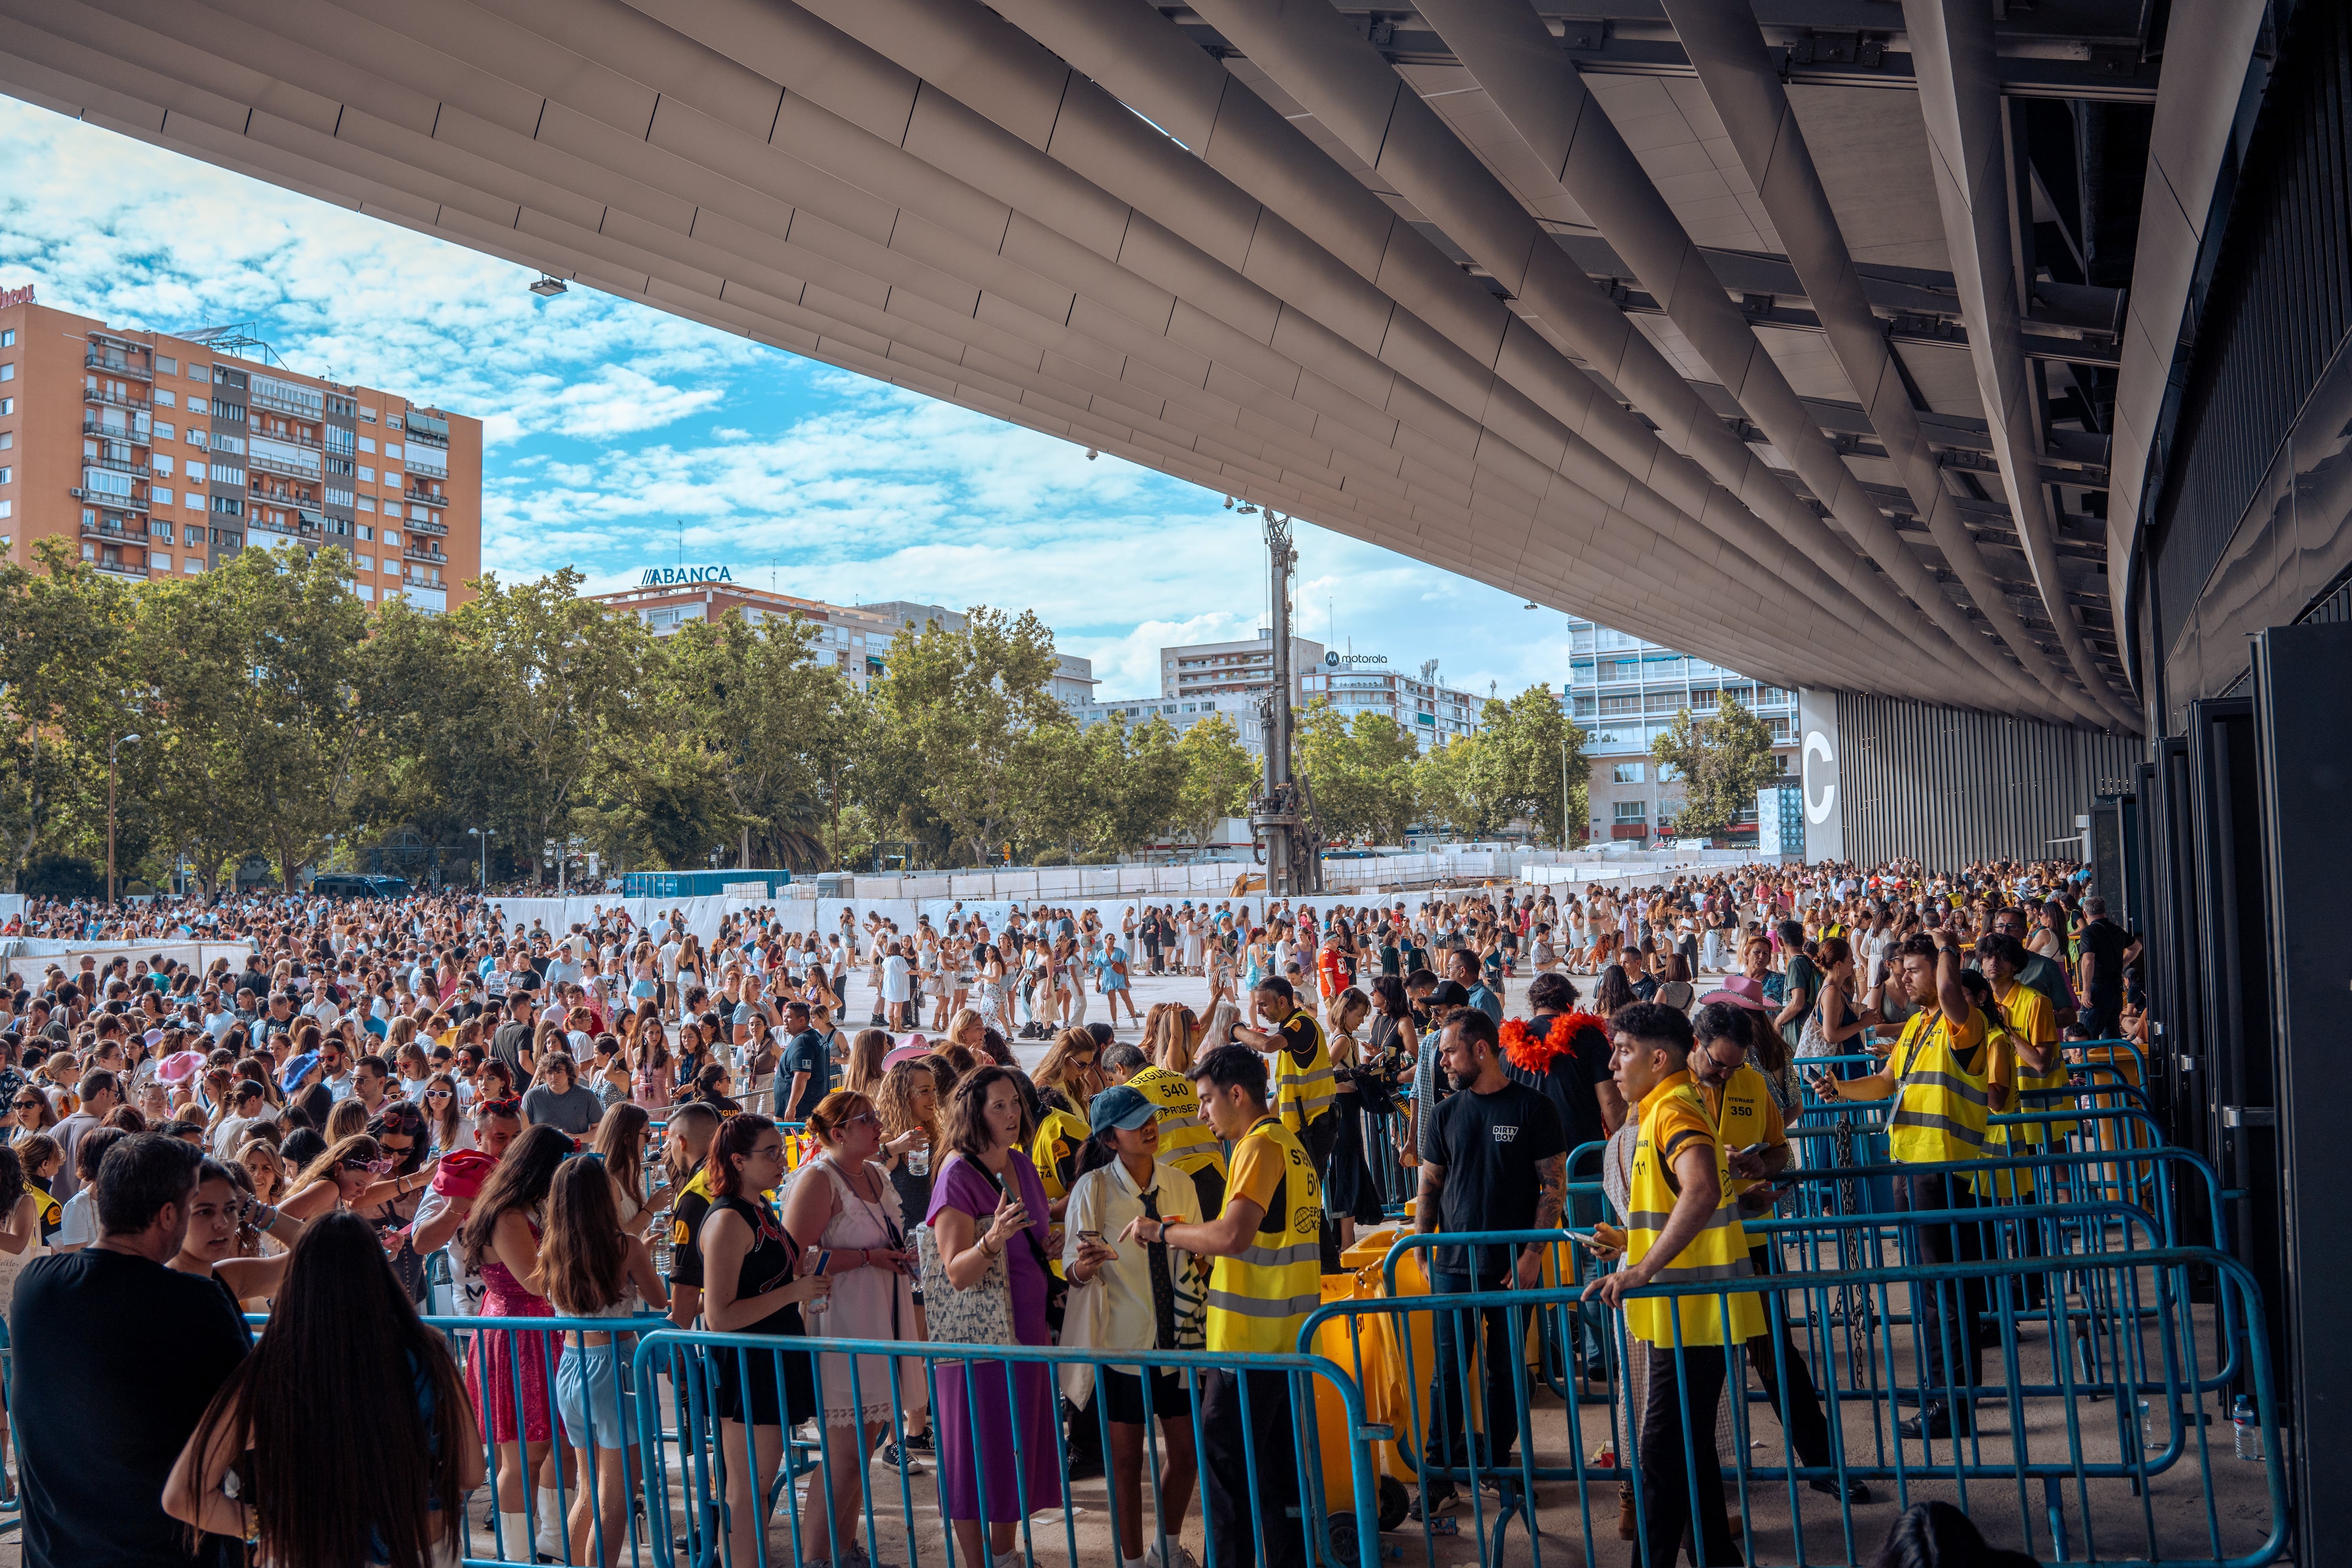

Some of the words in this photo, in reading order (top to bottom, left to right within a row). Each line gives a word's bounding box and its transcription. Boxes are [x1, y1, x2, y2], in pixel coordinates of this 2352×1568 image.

[650, 566, 732, 584] ABANCA
[1342, 654, 1387, 663] motorola
[1803, 731, 1835, 824] C
[1160, 1083, 1188, 1098] 540
[460, 1097, 464, 1105] A
[1731, 1106, 1752, 1116] 350
[1493, 1126, 1518, 1134] DIRTY
[1038, 1170, 1052, 1179] 74
